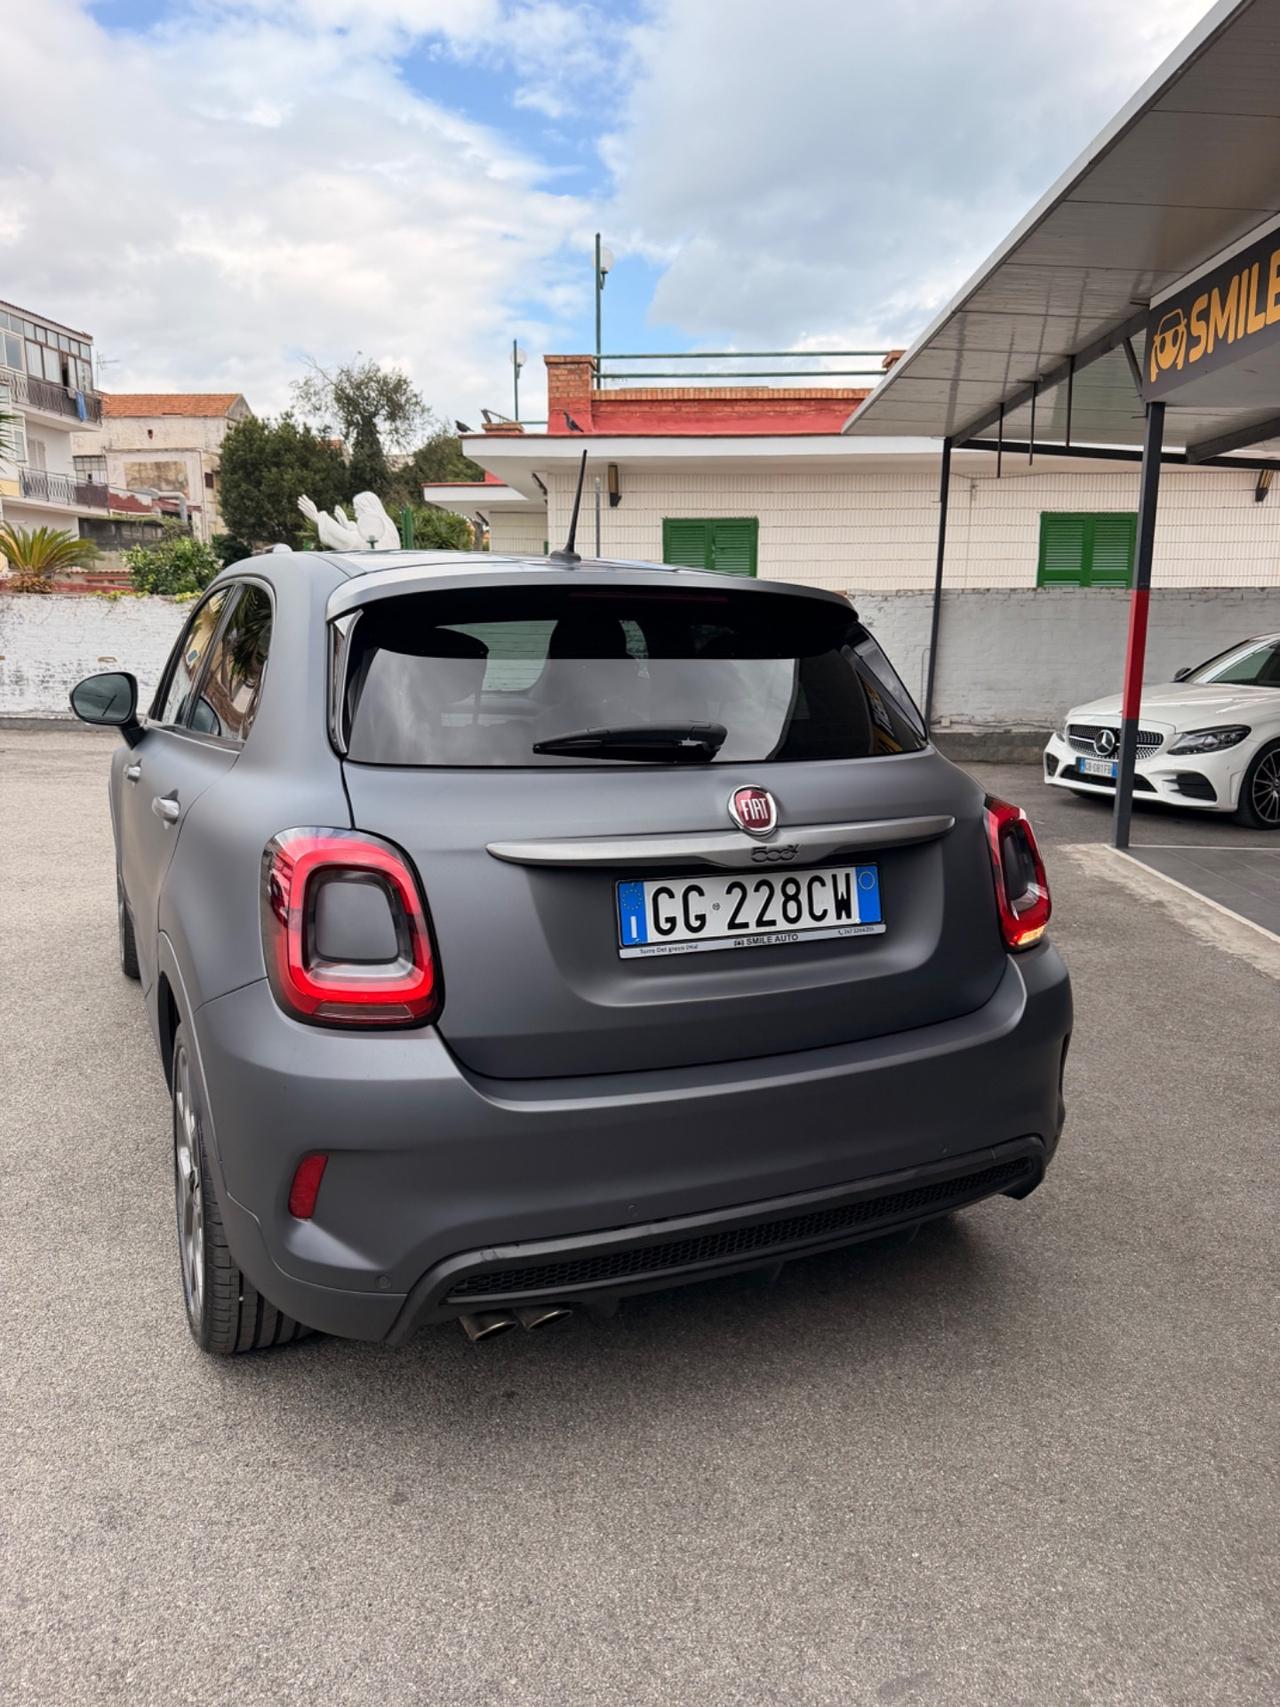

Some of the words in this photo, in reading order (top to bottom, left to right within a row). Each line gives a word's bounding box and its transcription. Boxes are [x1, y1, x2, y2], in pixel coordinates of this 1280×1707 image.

[1188, 249, 1280, 363] SMILE
[740, 798, 768, 821] FIAT
[651, 884, 707, 936] GG
[725, 872, 852, 930] 228CW
[746, 935, 773, 946] SMILE
[774, 933, 799, 943] AUTO
